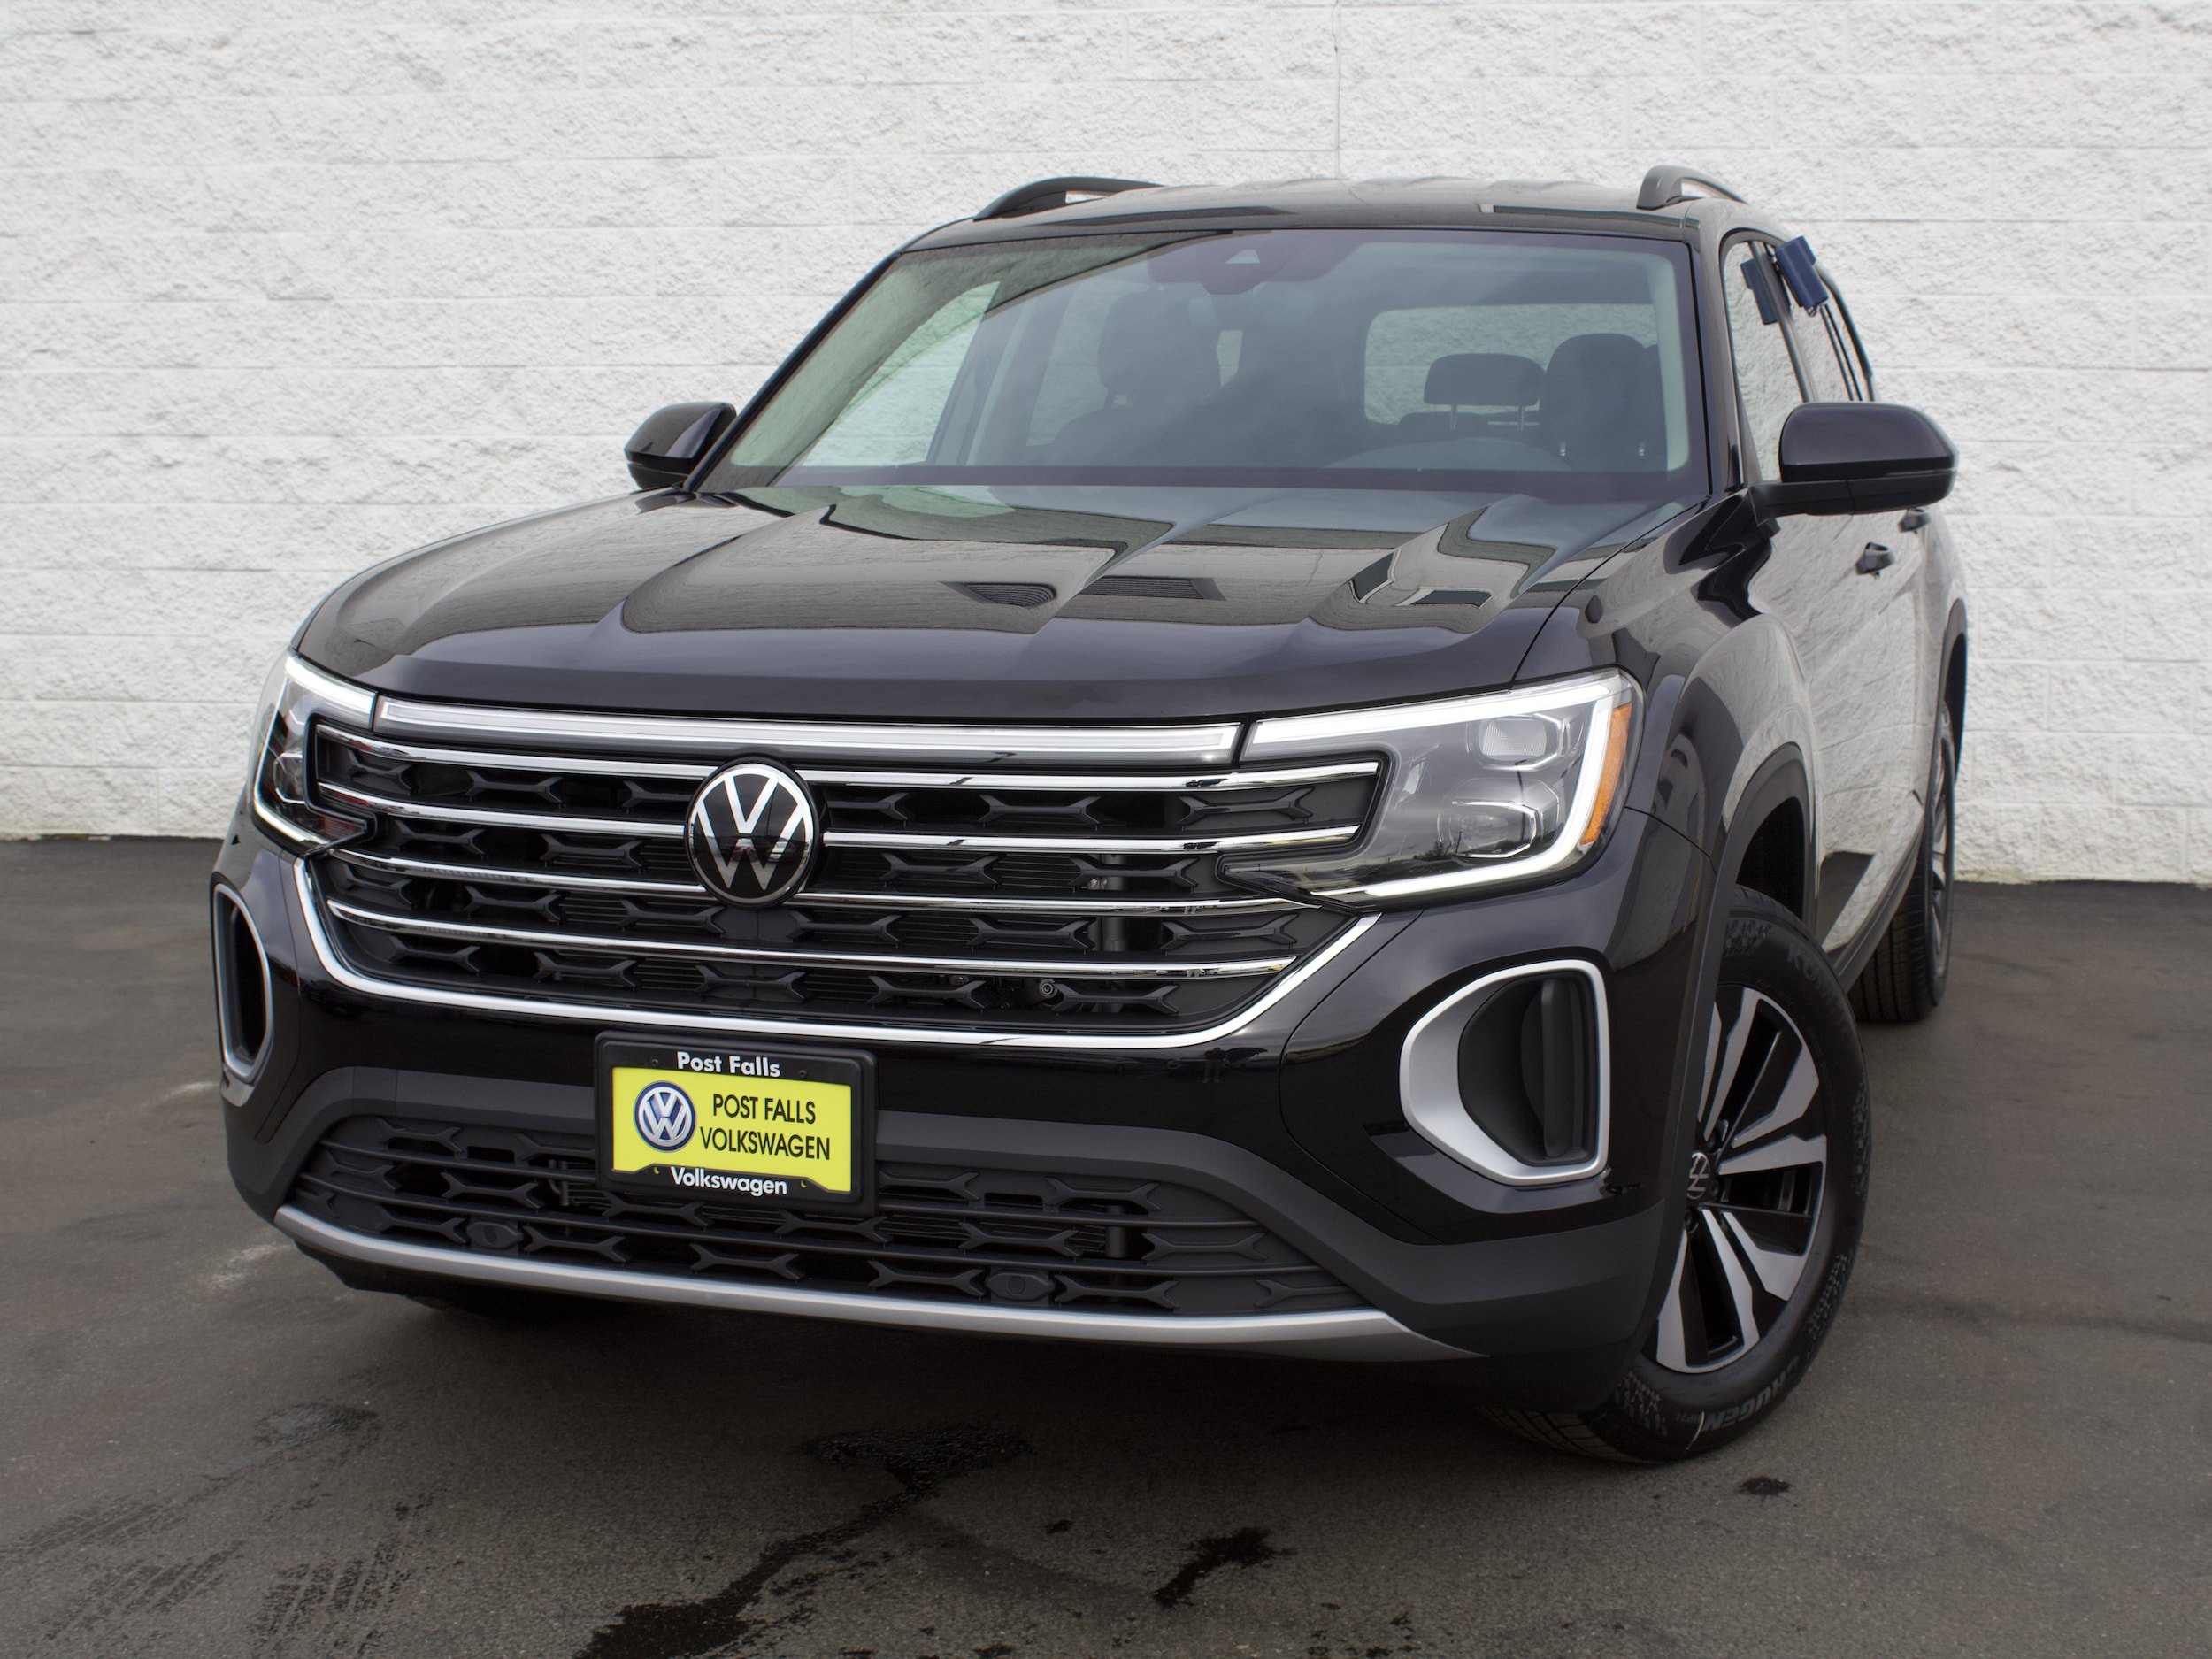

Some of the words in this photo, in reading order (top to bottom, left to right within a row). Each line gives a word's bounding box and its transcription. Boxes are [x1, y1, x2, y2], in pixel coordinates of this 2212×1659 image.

[676, 1051, 722, 1073] Post
[728, 1055, 781, 1078] Falls
[712, 1094, 758, 1120] POST
[764, 1098, 816, 1125] FALLS
[700, 1126, 830, 1161] VOLKSWAGEN
[671, 1166, 787, 1197] Volkswagen
